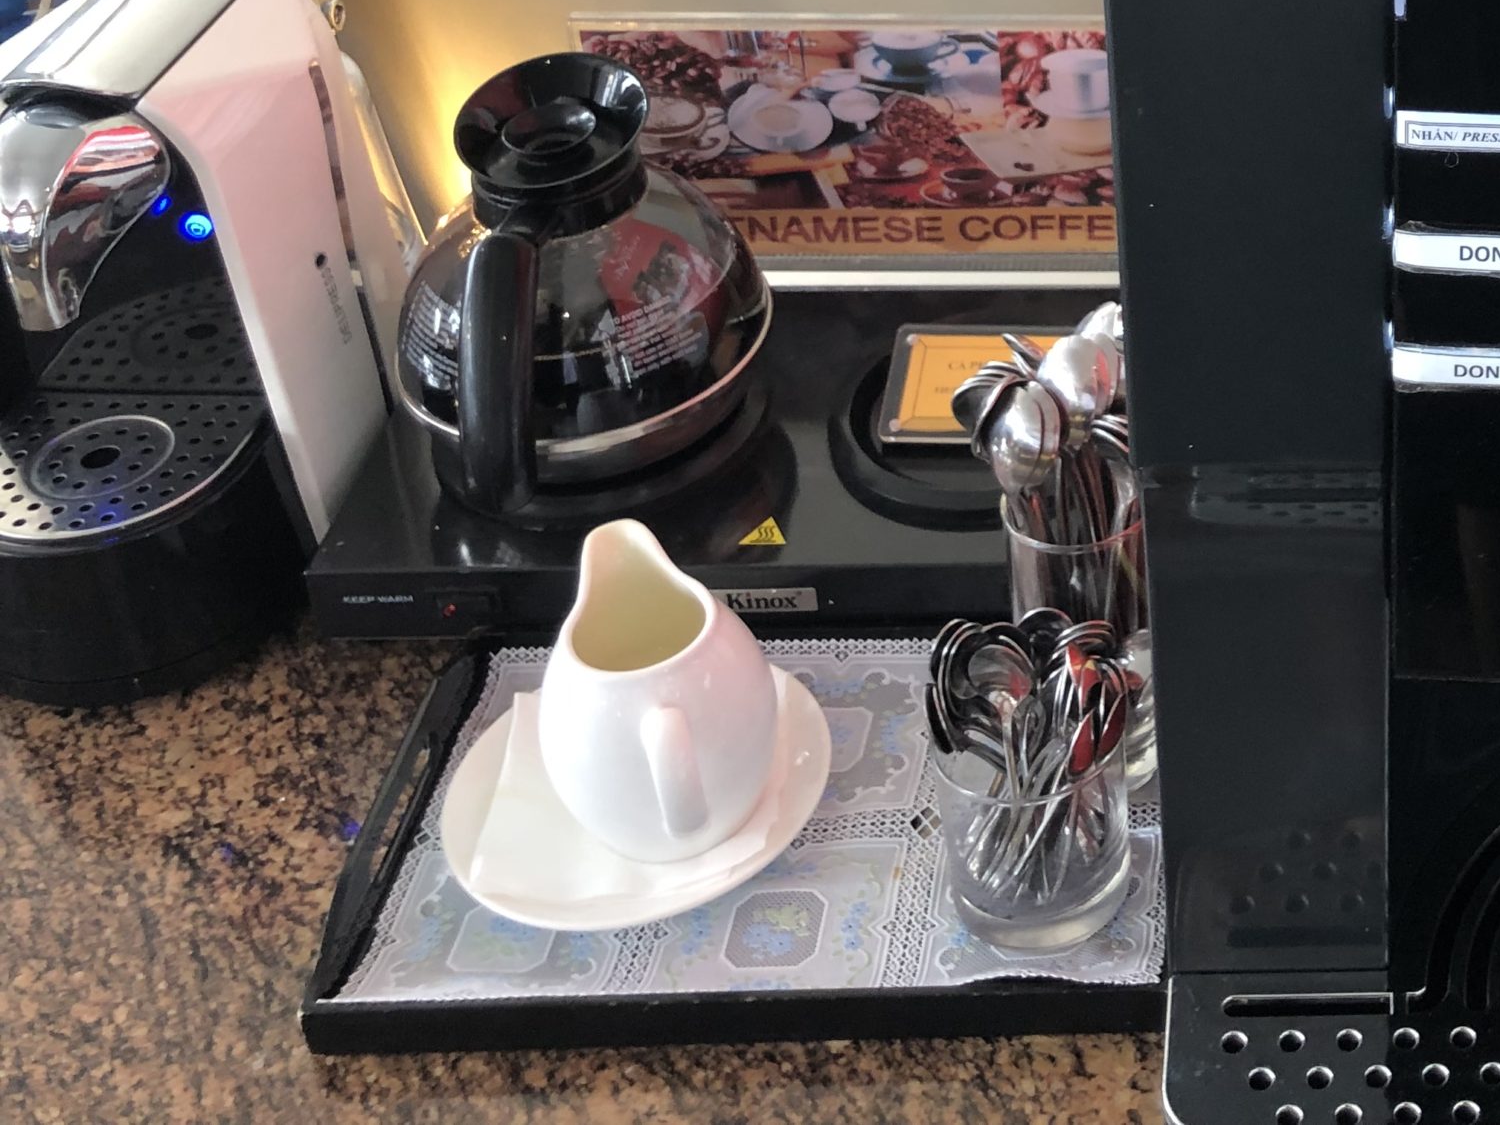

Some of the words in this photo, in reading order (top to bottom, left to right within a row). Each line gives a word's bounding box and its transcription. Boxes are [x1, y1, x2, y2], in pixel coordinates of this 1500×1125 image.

[342, 595, 375, 604] KEEP
[377, 594, 415, 604] WARM
[725, 592, 798, 610] Kinox
